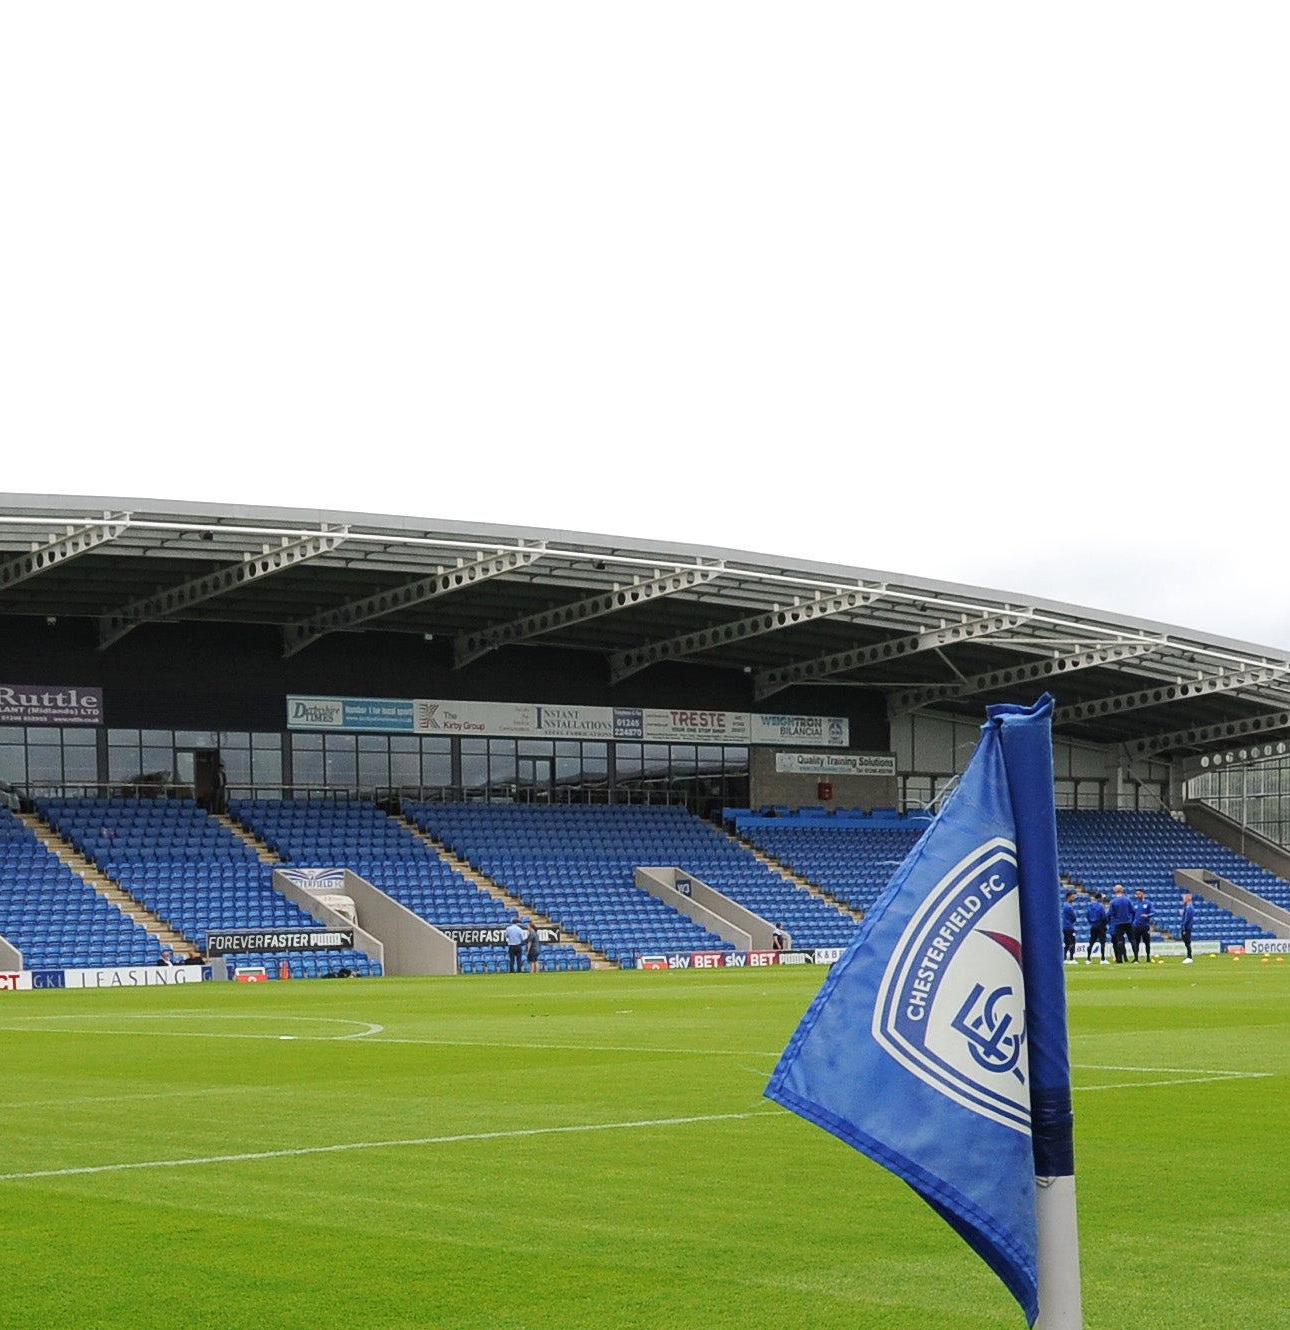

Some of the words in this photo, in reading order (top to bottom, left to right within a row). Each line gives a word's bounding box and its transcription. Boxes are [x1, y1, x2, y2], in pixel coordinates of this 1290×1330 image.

[27, 707, 78, 716] (Midlands)
[306, 713, 334, 722] TIMES
[444, 711, 458, 720] The
[670, 711, 726, 727] TRESTE
[761, 716, 822, 728] WEIGHTRON
[443, 721, 462, 731] Kirby
[463, 721, 486, 731] Group
[797, 755, 825, 766] Quality
[826, 756, 856, 768] Training
[858, 757, 894, 767] Solutions
[311, 932, 342, 947] PUMA
[906, 895, 982, 1021] CHESTERFIELD
[979, 874, 1005, 899] FC
[668, 953, 691, 969] sky
[694, 954, 721, 968] BET
[725, 952, 746, 967] sky
[750, 953, 776, 966] BET
[778, 953, 806, 965] PUMA
[82, 969, 186, 988] LEASING
